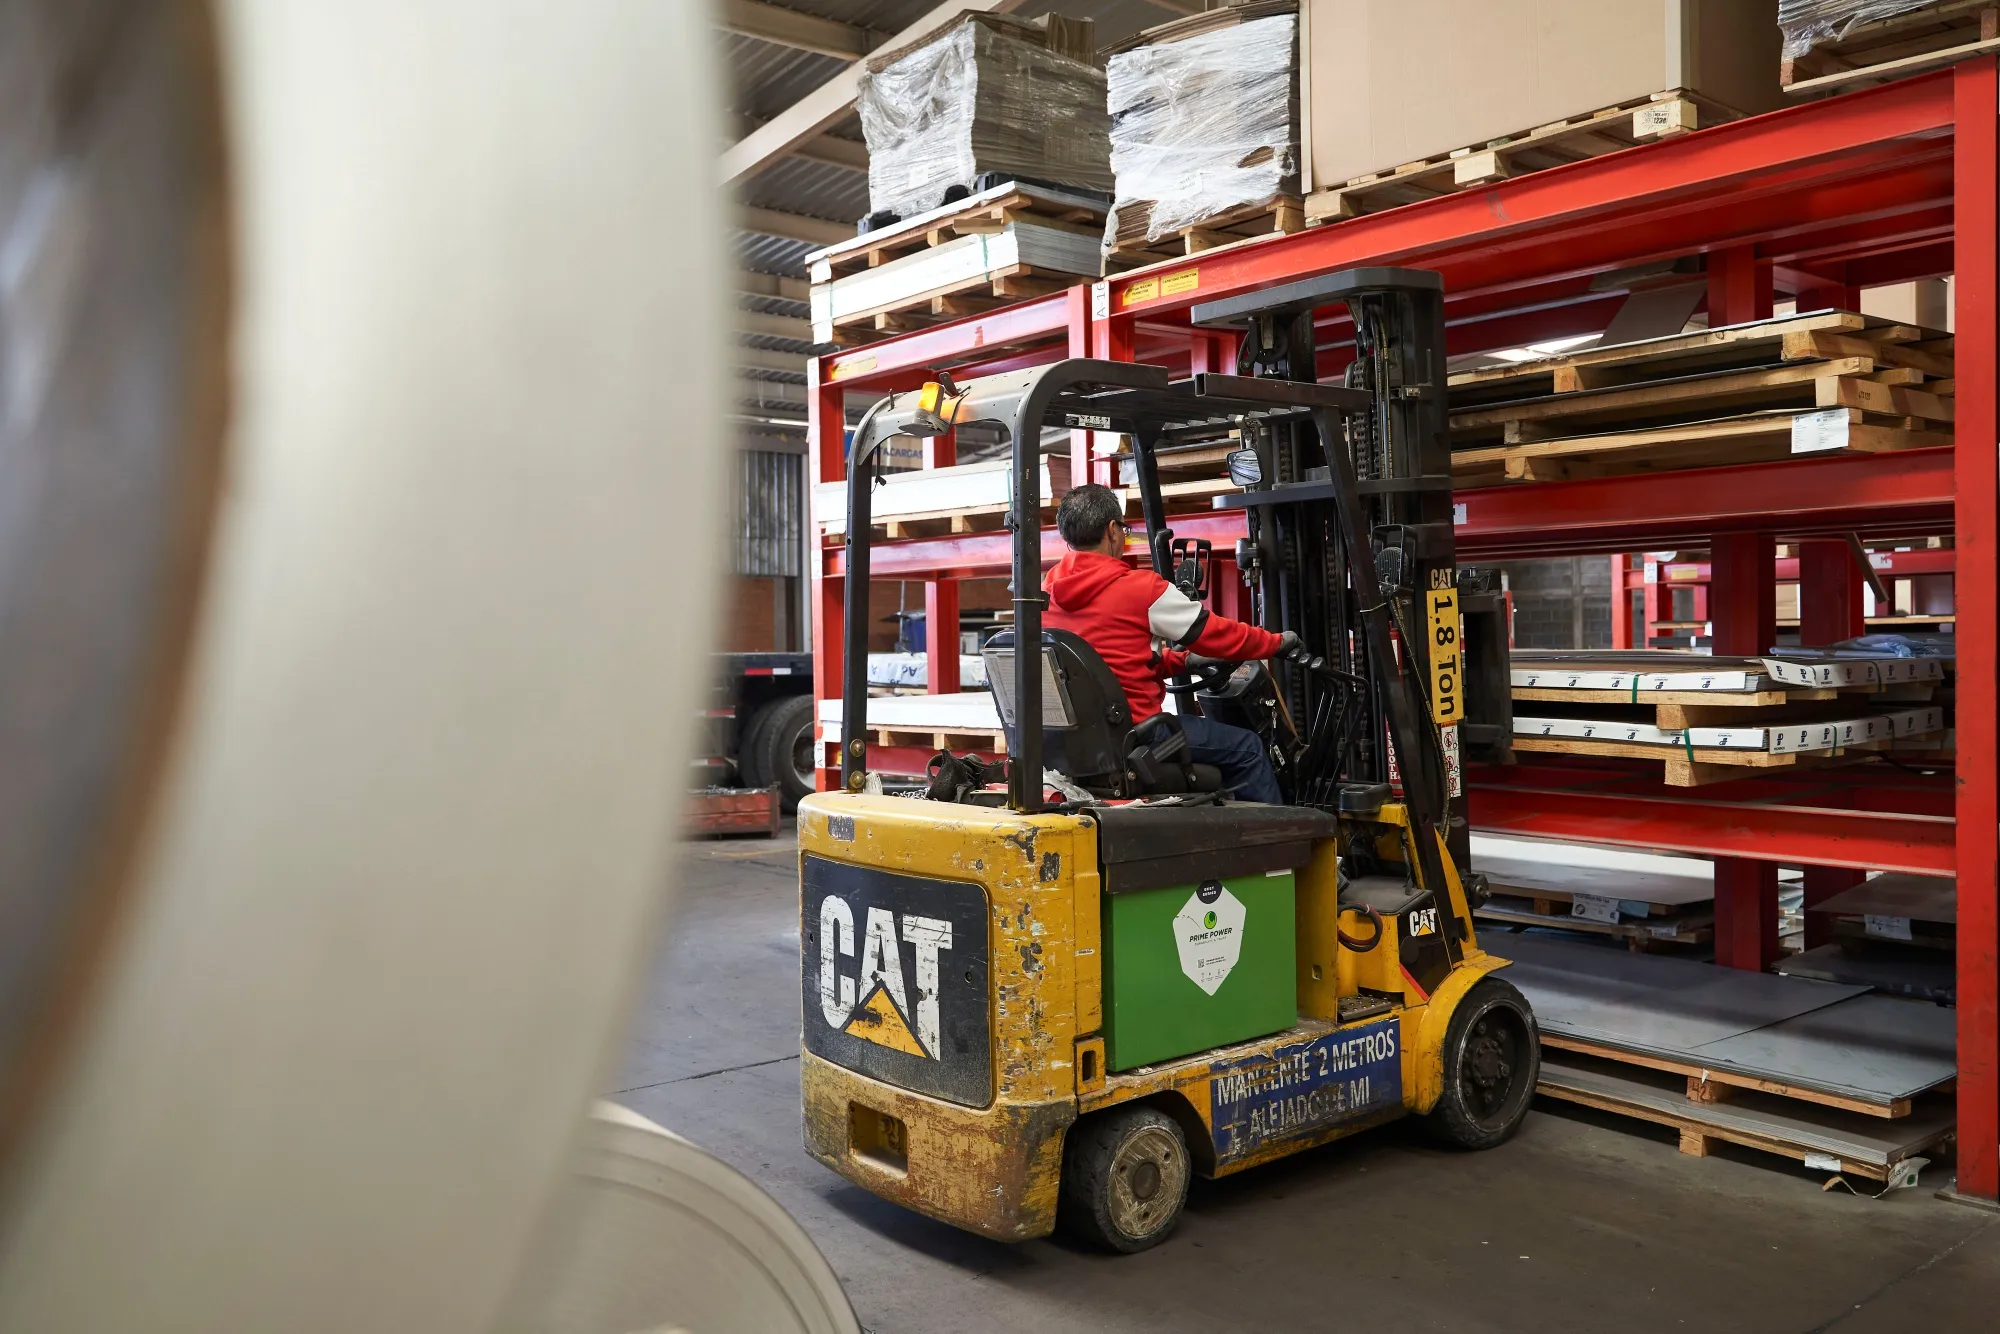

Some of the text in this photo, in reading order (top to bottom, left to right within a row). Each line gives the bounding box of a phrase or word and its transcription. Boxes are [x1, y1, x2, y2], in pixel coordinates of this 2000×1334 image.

[1430, 568, 1453, 589] CAT
[1433, 595, 1455, 647] 1.8
[1437, 654, 1457, 716] Ton
[1189, 927, 1233, 942] PRIME POWER
[1409, 907, 1437, 937] CAT
[820, 894, 953, 1062] CAT
[1318, 1045, 1329, 1077] 2
[1332, 1028, 1395, 1073] METROS
[1350, 1075, 1370, 1109] MI
